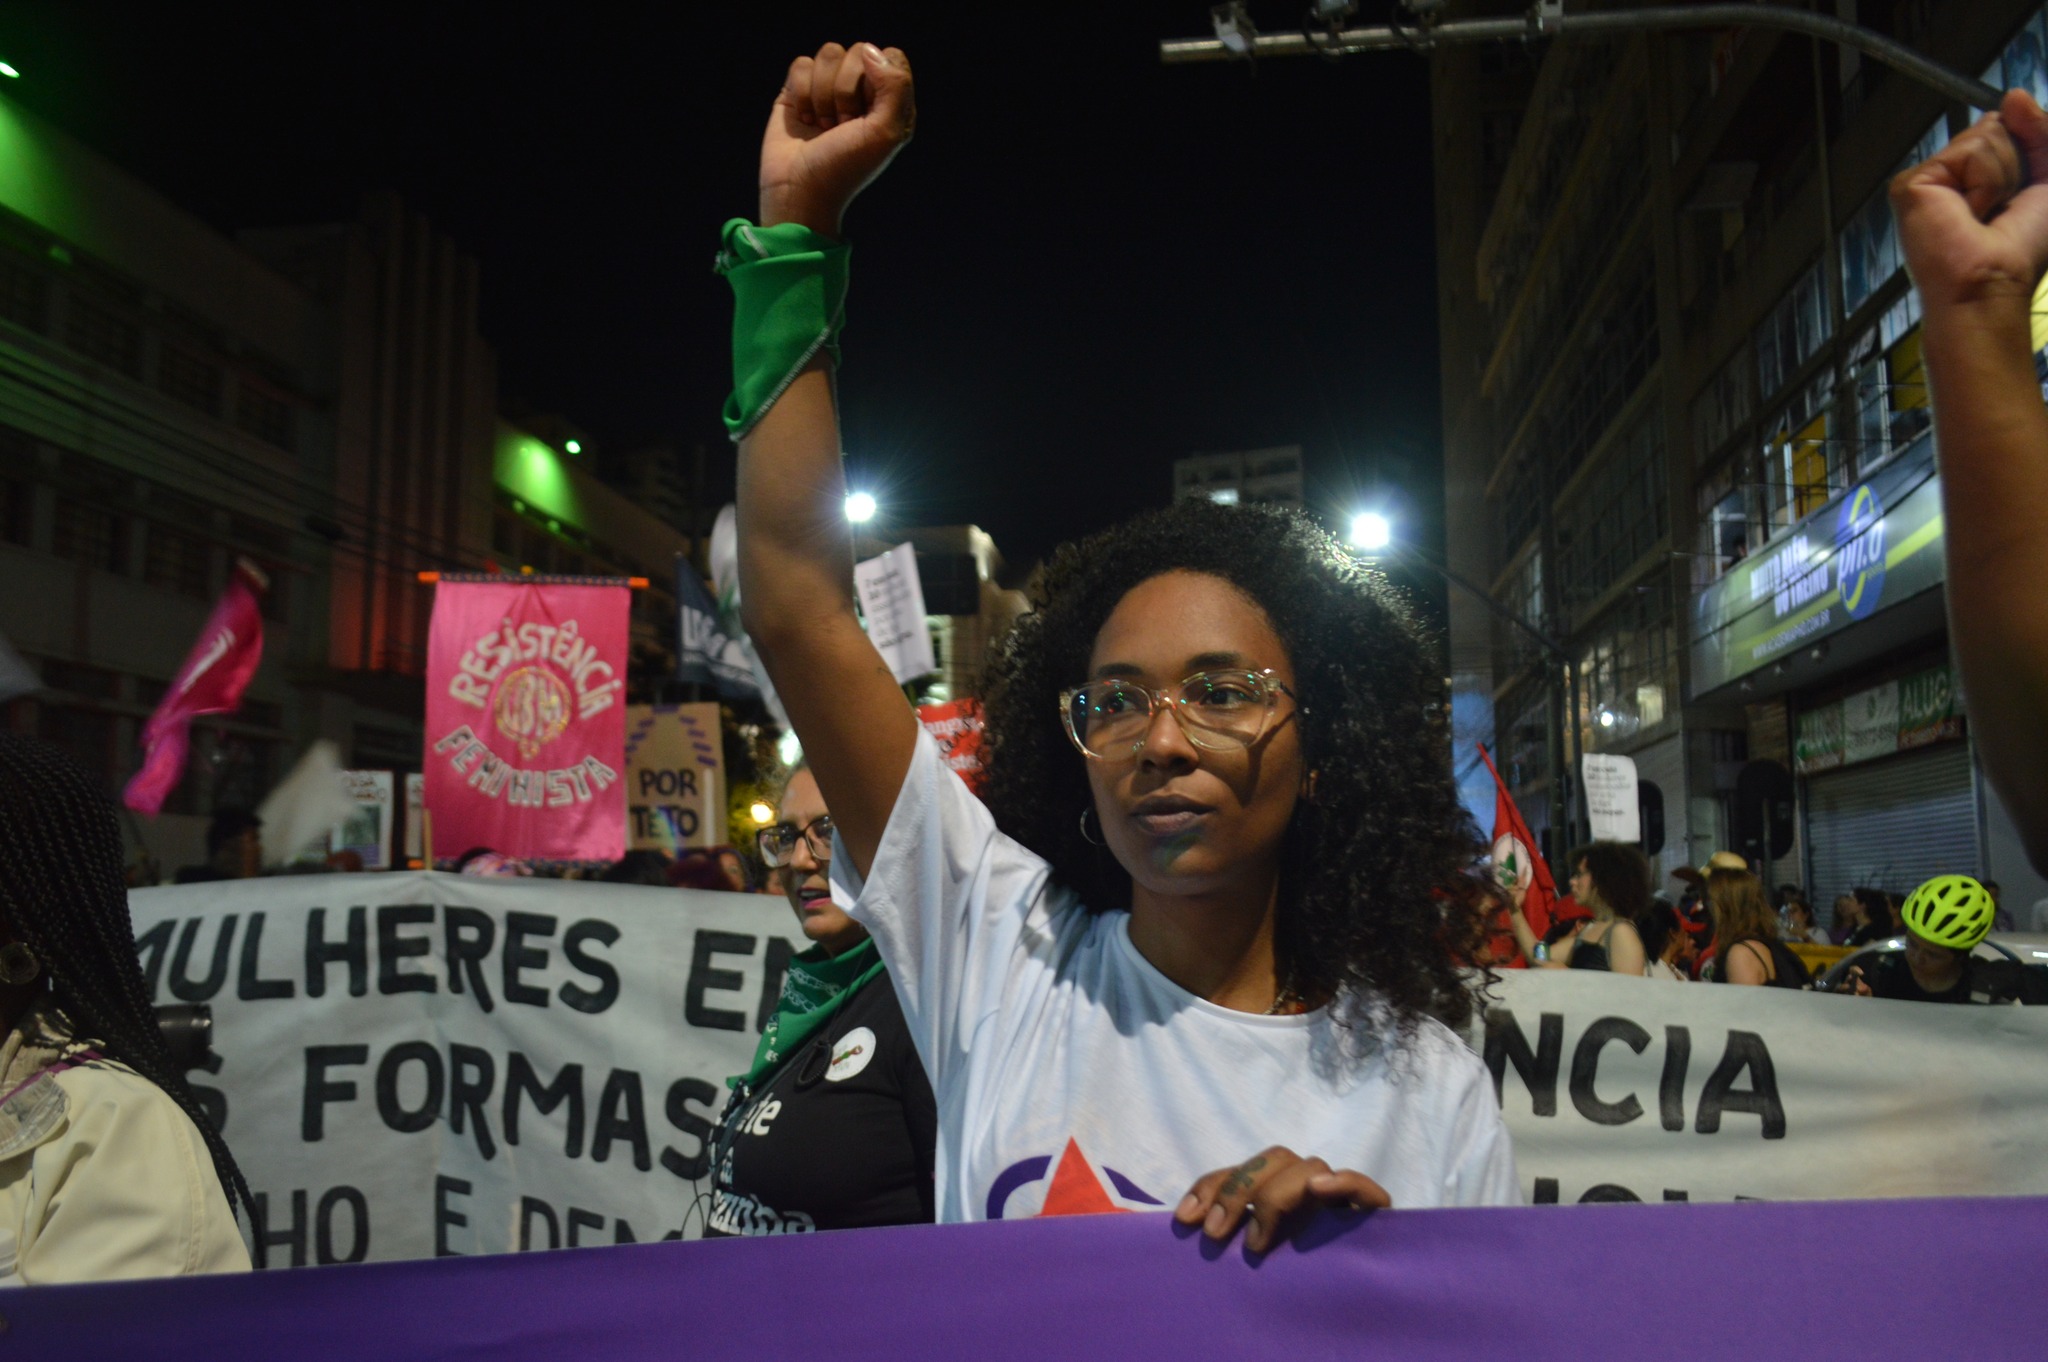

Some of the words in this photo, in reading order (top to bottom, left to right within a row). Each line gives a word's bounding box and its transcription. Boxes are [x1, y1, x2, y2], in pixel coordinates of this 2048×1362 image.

[434, 723, 618, 808] FEMINISTA
[640, 768, 698, 797] POR
[301, 1040, 721, 1181] FORMAS
[1483, 1008, 1786, 1140] NCIA
[253, 1184, 370, 1269] HO
